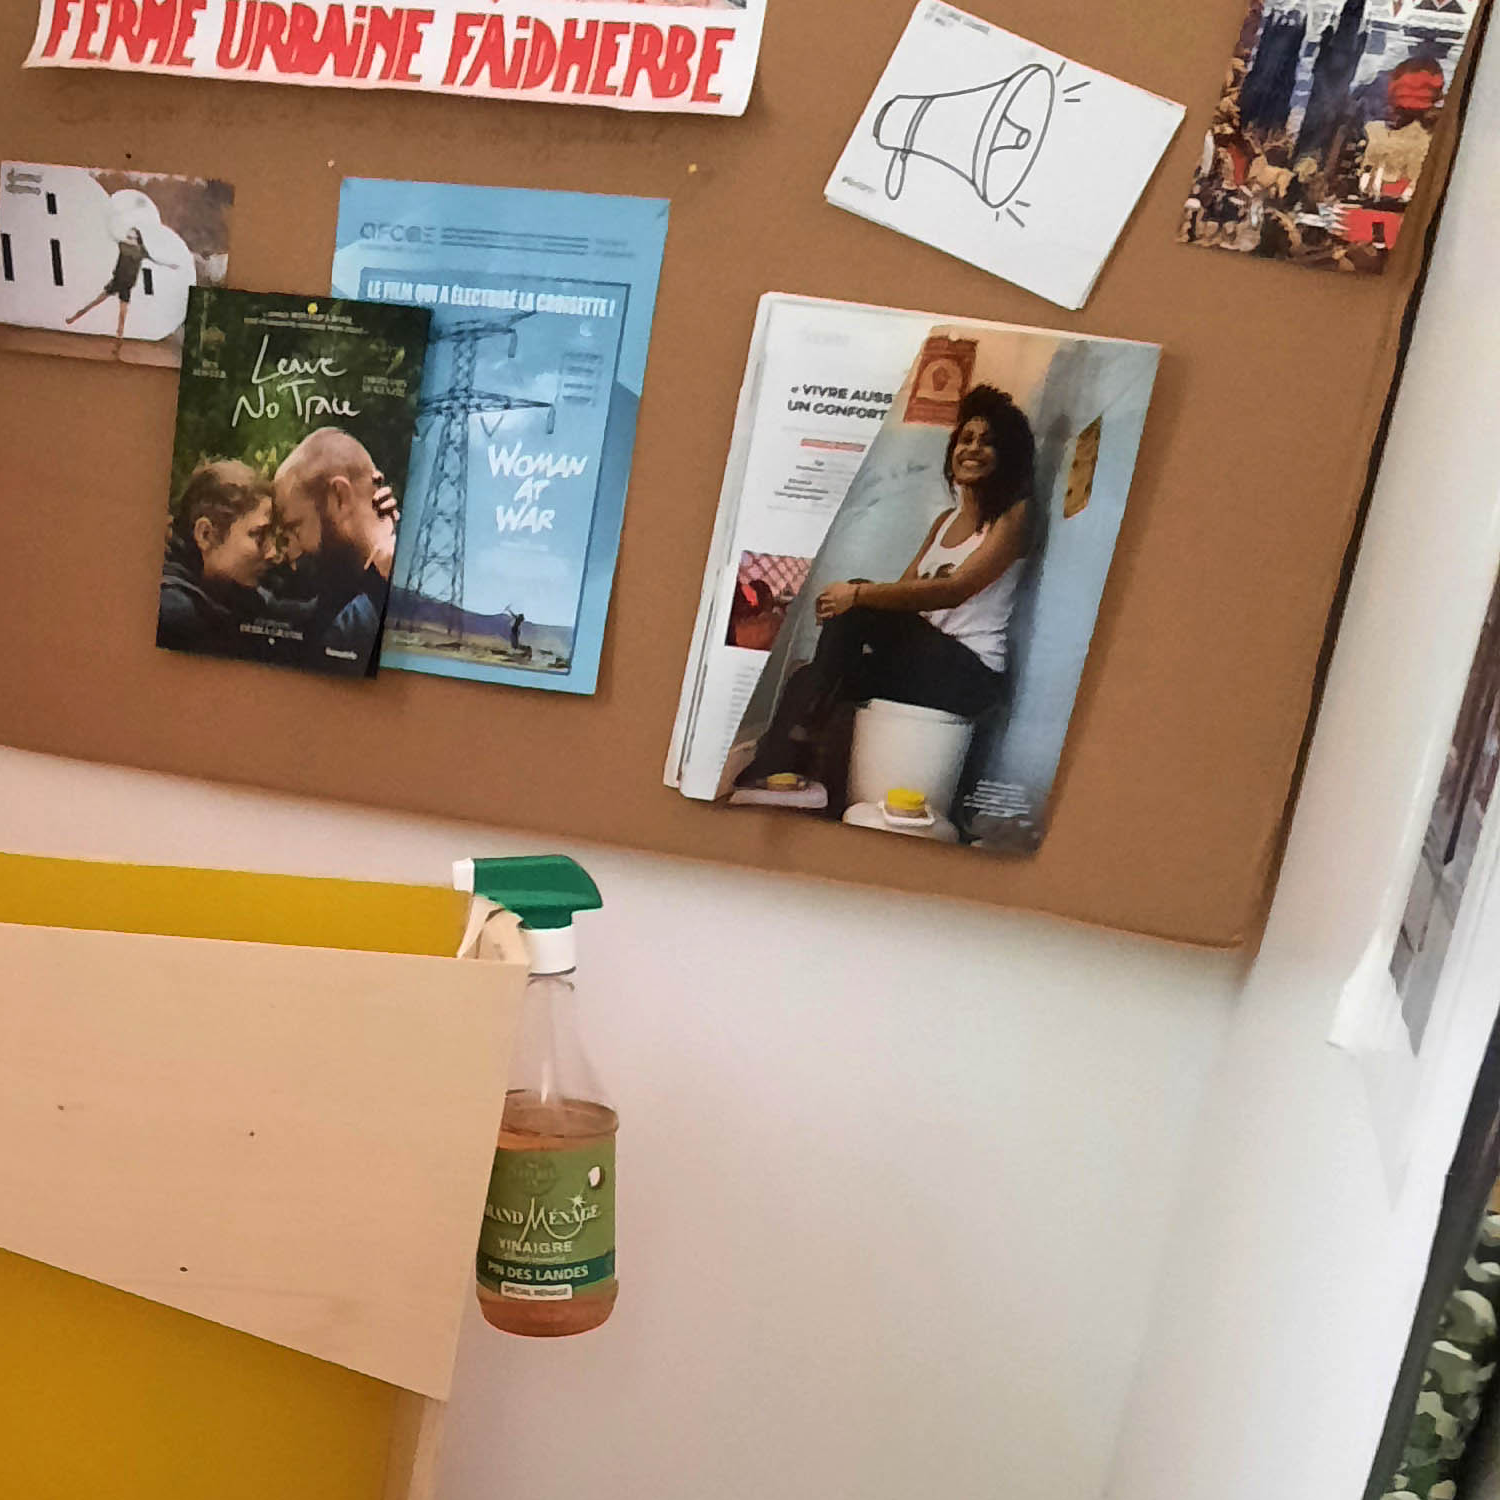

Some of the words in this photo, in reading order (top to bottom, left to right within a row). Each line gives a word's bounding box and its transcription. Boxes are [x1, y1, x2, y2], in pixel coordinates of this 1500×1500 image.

[41, 0, 206, 69] FERME
[252, 333, 349, 384] Leave
[802, 384, 849, 400] VIVRE
[231, 385, 280, 427] No
[787, 400, 811, 413] UN
[488, 440, 588, 478] WOMAN
[514, 476, 550, 503] AT
[496, 505, 555, 533] WAR
[499, 1239, 573, 1254] VINAIGRE
[507, 1266, 533, 1281] DES
[536, 1265, 589, 1281] LANDES
